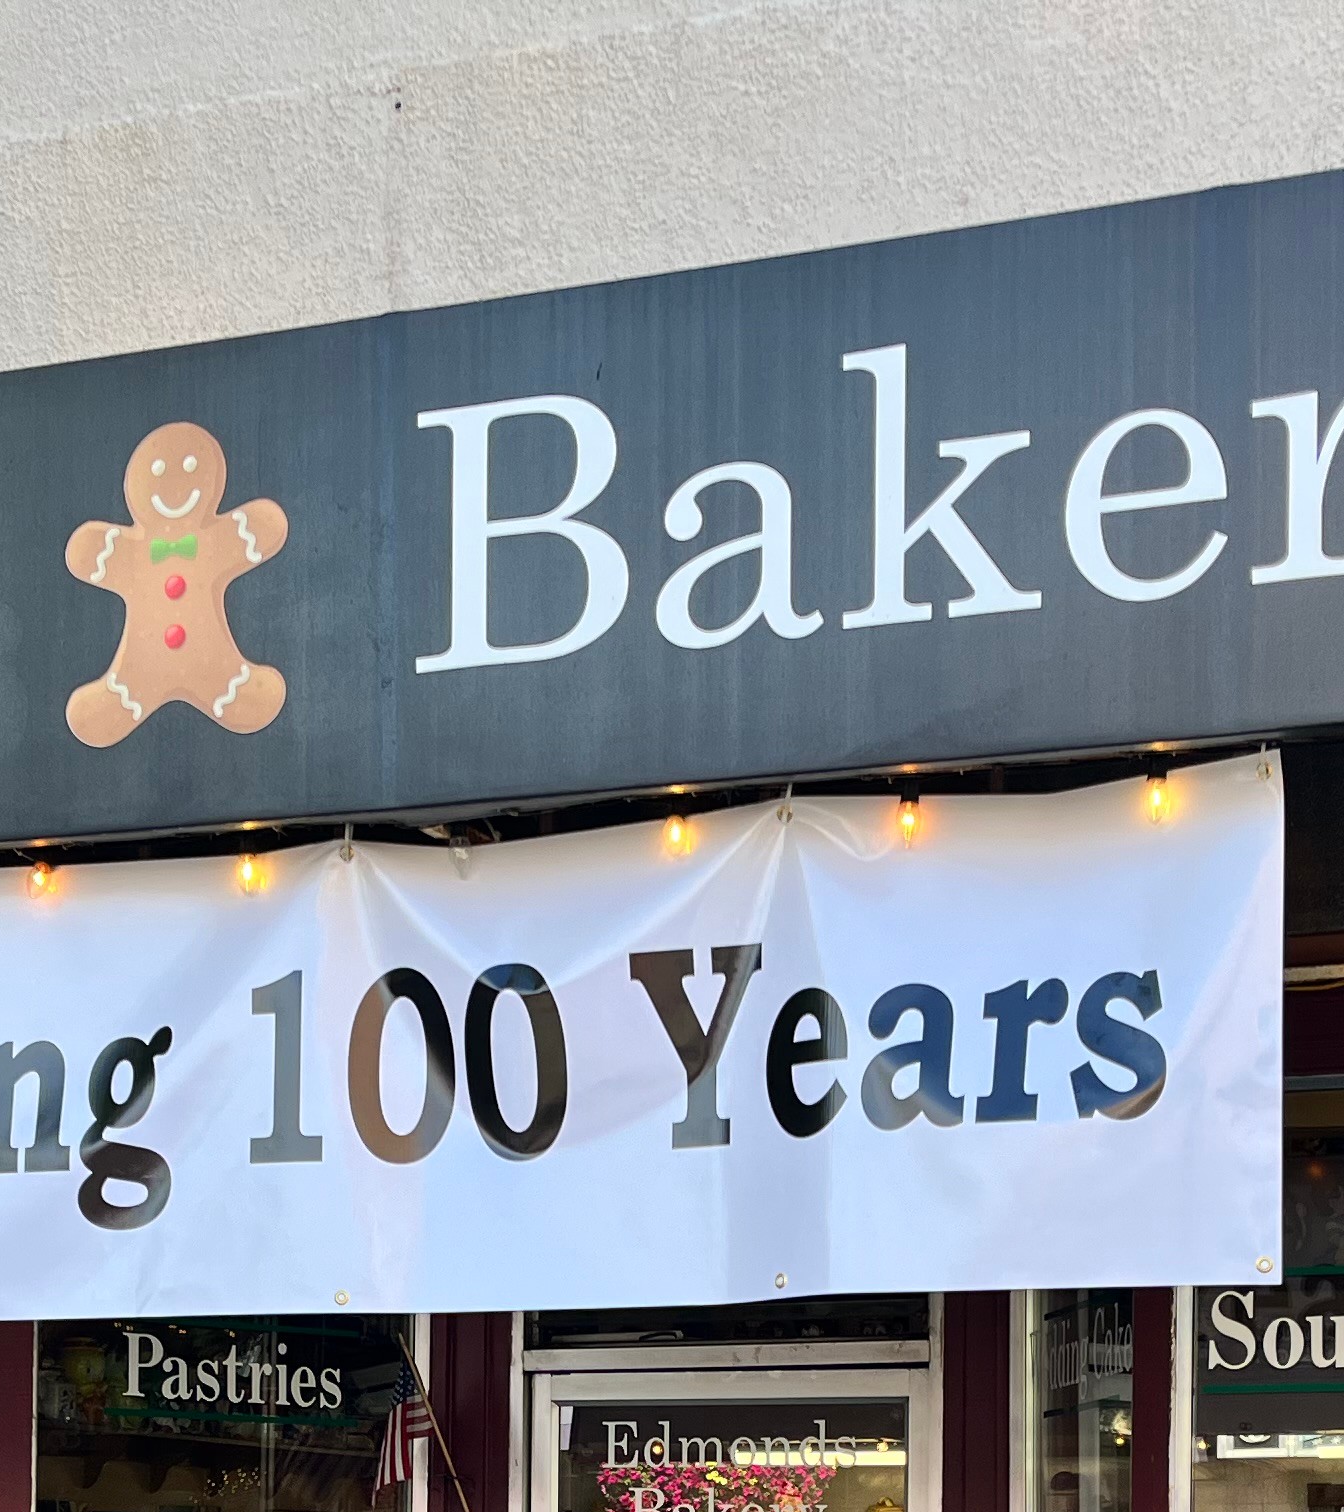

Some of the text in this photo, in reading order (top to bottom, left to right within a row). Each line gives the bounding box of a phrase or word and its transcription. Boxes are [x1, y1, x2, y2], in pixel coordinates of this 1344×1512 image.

[248, 962, 569, 1165] 100
[628, 942, 1168, 1150] Years
[122, 1331, 343, 1410] Pastries
[1092, 1302, 1134, 1380] Cake
[601, 1419, 857, 1470] Edmonds
